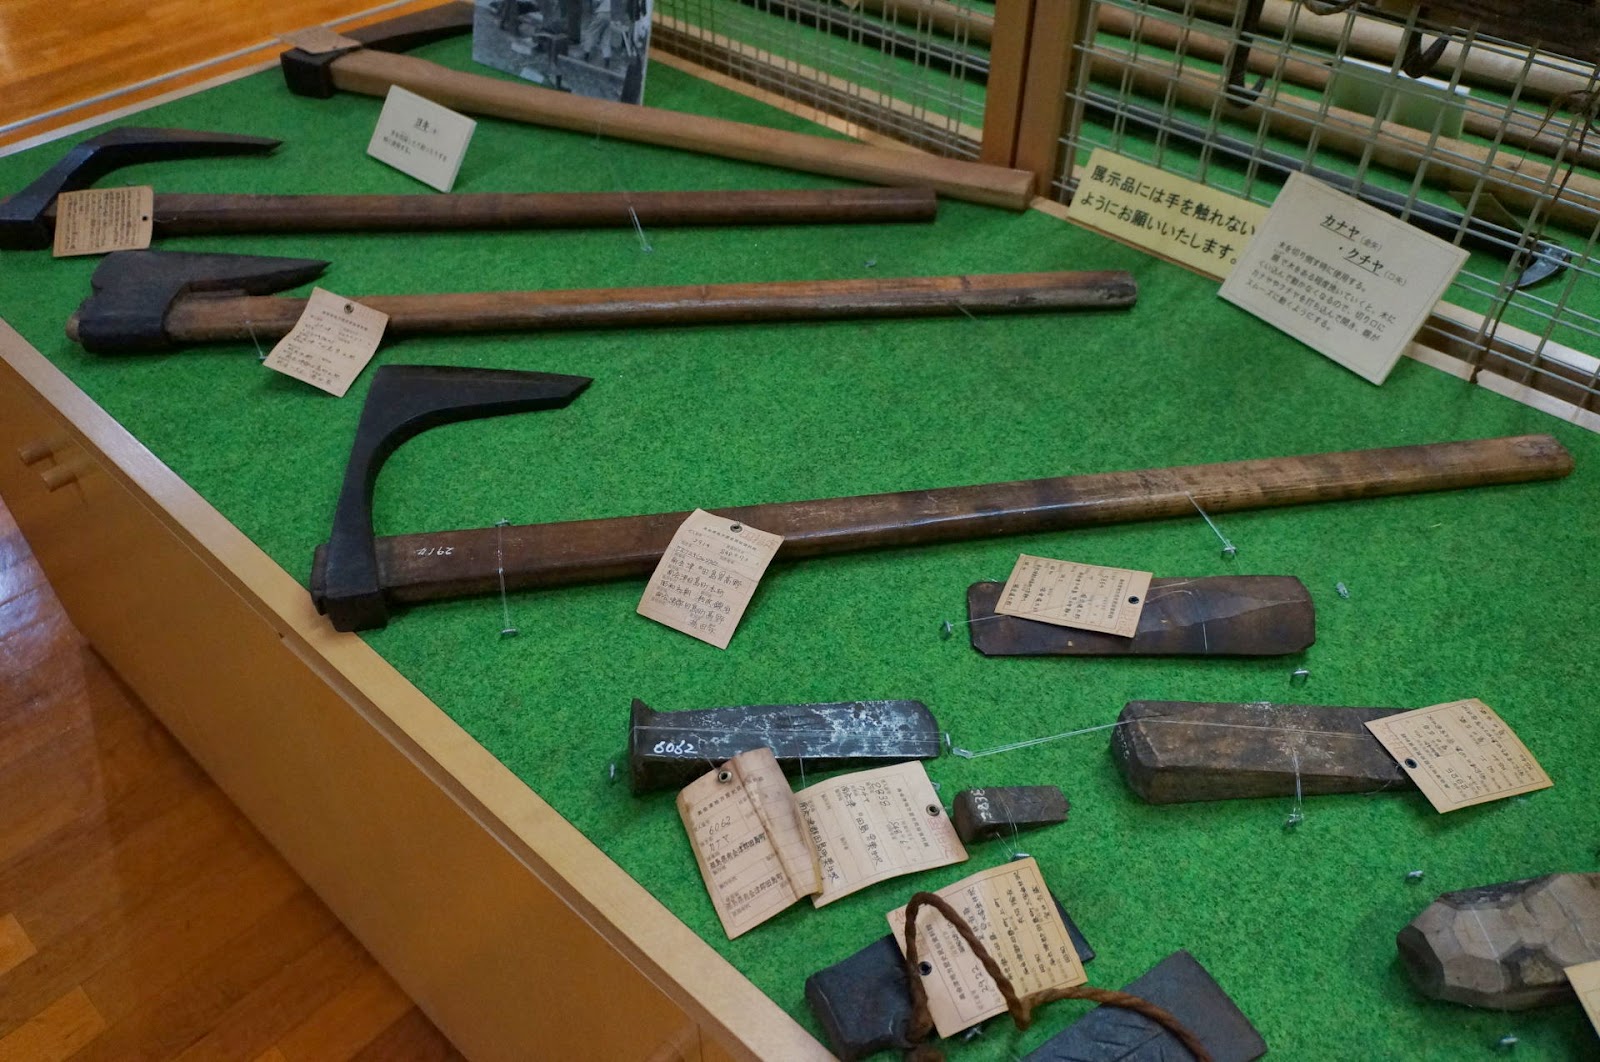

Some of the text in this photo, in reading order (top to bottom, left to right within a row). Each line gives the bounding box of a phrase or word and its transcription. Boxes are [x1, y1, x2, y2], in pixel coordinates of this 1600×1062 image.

[1090, 164, 1256, 236] 展示品には手を触れない
[1080, 191, 1238, 265] ようにお願いいたします。
[653, 740, 698, 754] 6062
[968, 963, 990, 993] 2922
